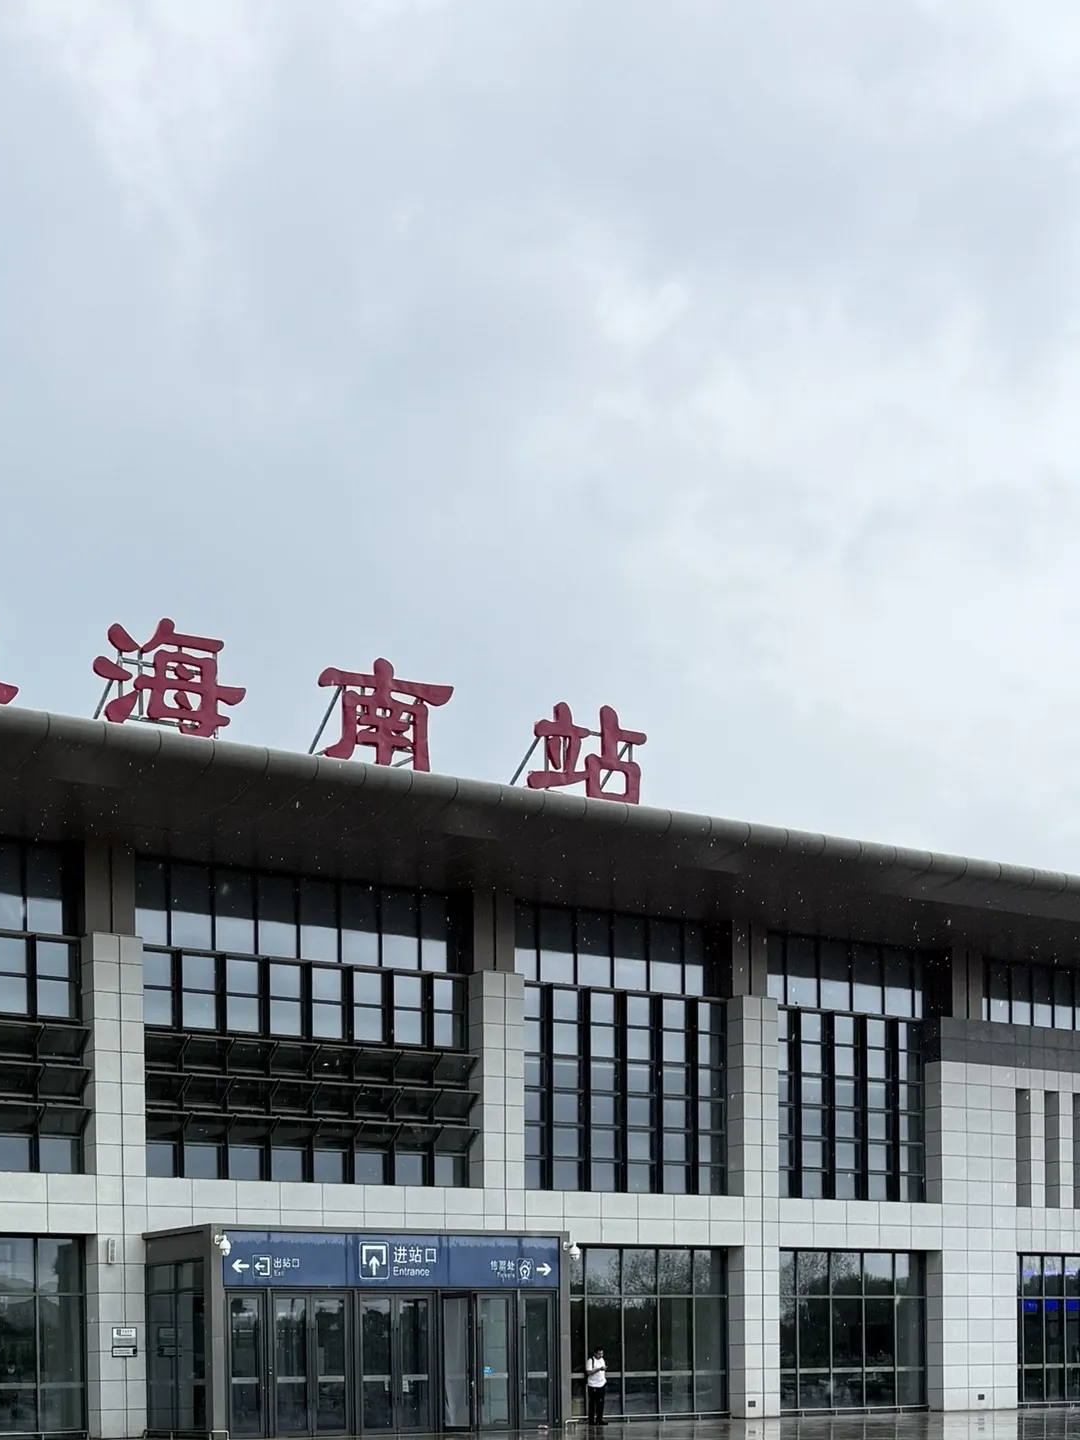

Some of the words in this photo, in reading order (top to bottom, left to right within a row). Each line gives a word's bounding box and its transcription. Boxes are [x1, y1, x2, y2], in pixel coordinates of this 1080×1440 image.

[393, 1245, 437, 1264] 进站口
[273, 1257, 300, 1269] 出站口
[393, 1265, 431, 1277] Entrance
